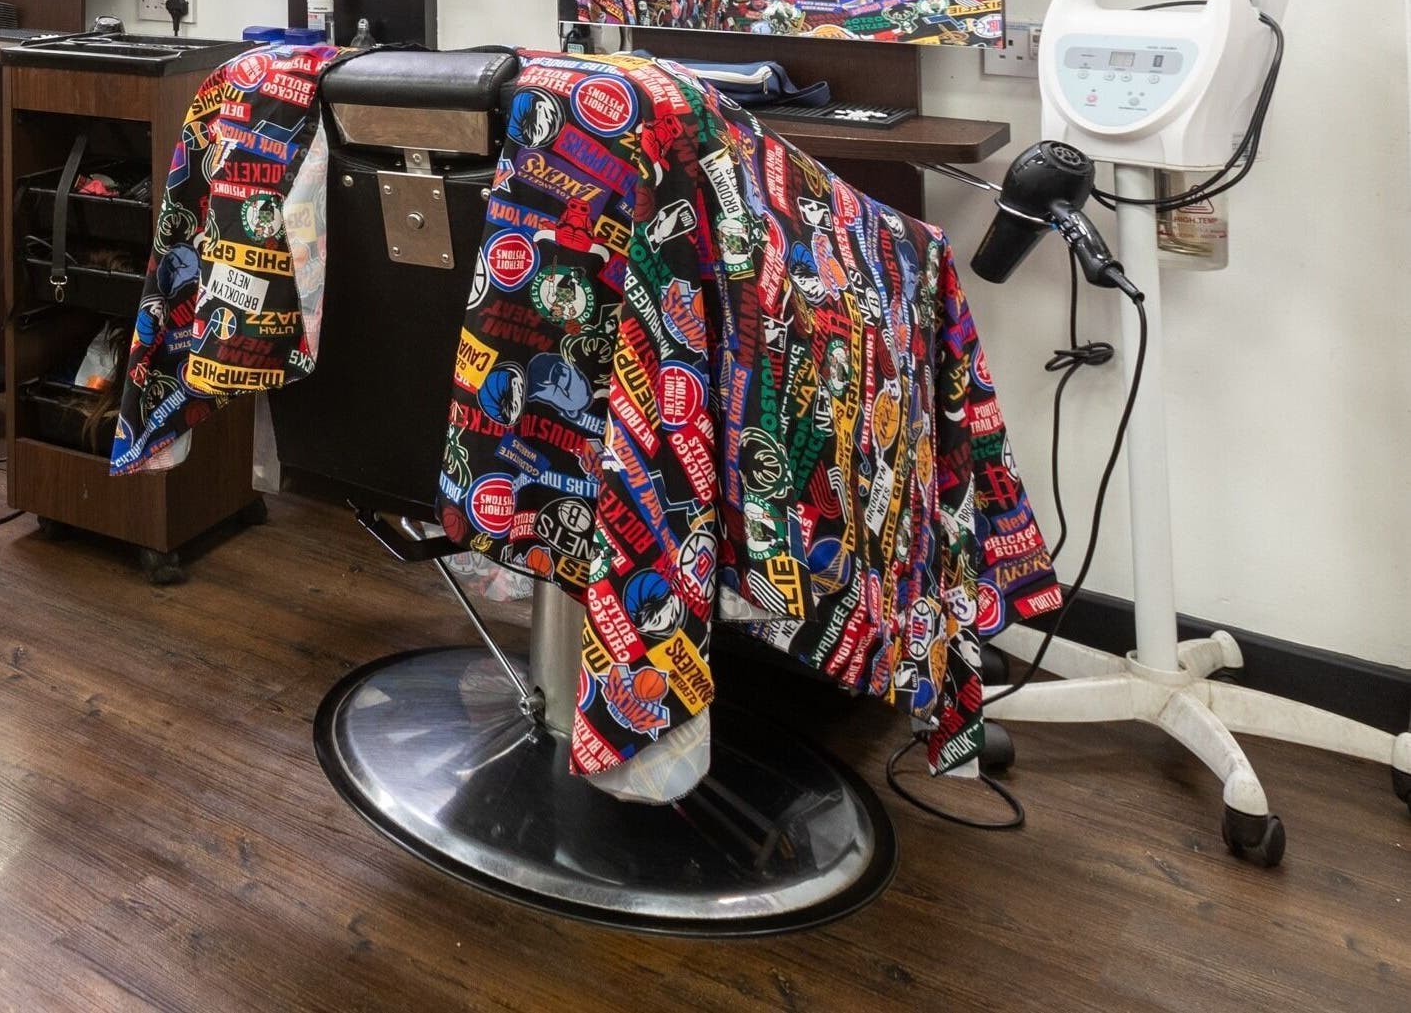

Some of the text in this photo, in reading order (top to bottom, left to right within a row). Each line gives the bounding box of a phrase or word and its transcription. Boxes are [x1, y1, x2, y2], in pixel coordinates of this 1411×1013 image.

[273, 72, 313, 94] BULLS
[586, 86, 624, 112] PISTONS
[583, 95, 620, 121] DETROIT
[259, 138, 287, 161] York
[213, 182, 247, 199] PISTONS
[223, 161, 287, 184] OCKETS
[521, 153, 604, 202] LAKERS
[703, 159, 740, 214] BROOKLYN
[490, 200, 520, 226] York
[678, 210, 695, 227] NBA
[495, 249, 526, 260] PISTONS
[495, 259, 525, 270] DETROIT
[211, 279, 259, 311] BROOKLYN
[227, 269, 251, 290] NETS
[531, 271, 595, 324] CELTICS BOSTON
[849, 269, 876, 326] NETS
[245, 311, 301, 325] JAZZ
[259, 325, 294, 335] UTAH
[627, 289, 675, 360] MILWAUKEE
[191, 359, 283, 388] MEMPHIS
[845, 294, 862, 421] GRIZZLIES
[663, 374, 675, 415] DETROIT
[791, 358, 813, 396] UTAH
[861, 332, 875, 445] DETROIT PISTONS
[153, 389, 187, 426] DALLAS
[675, 375, 687, 417] PISTONS
[613, 395, 655, 450] DETROIT
[727, 368, 748, 505] New York Knicks
[970, 419, 992, 434] TRAIL
[613, 426, 665, 529] York Knicks
[672, 432, 713, 502] CHICAGO
[688, 435, 717, 484] BULLS
[866, 465, 888, 524] BROOKLYN
[876, 488, 891, 517] NETS
[537, 514, 592, 560] NETS
[984, 524, 1037, 551] CHICAGO
[996, 510, 1028, 533] New
[994, 539, 1037, 558] BULLS
[994, 551, 1053, 589] LAKERS
[587, 587, 631, 663] CHICAGO
[602, 594, 638, 652] BULLS
